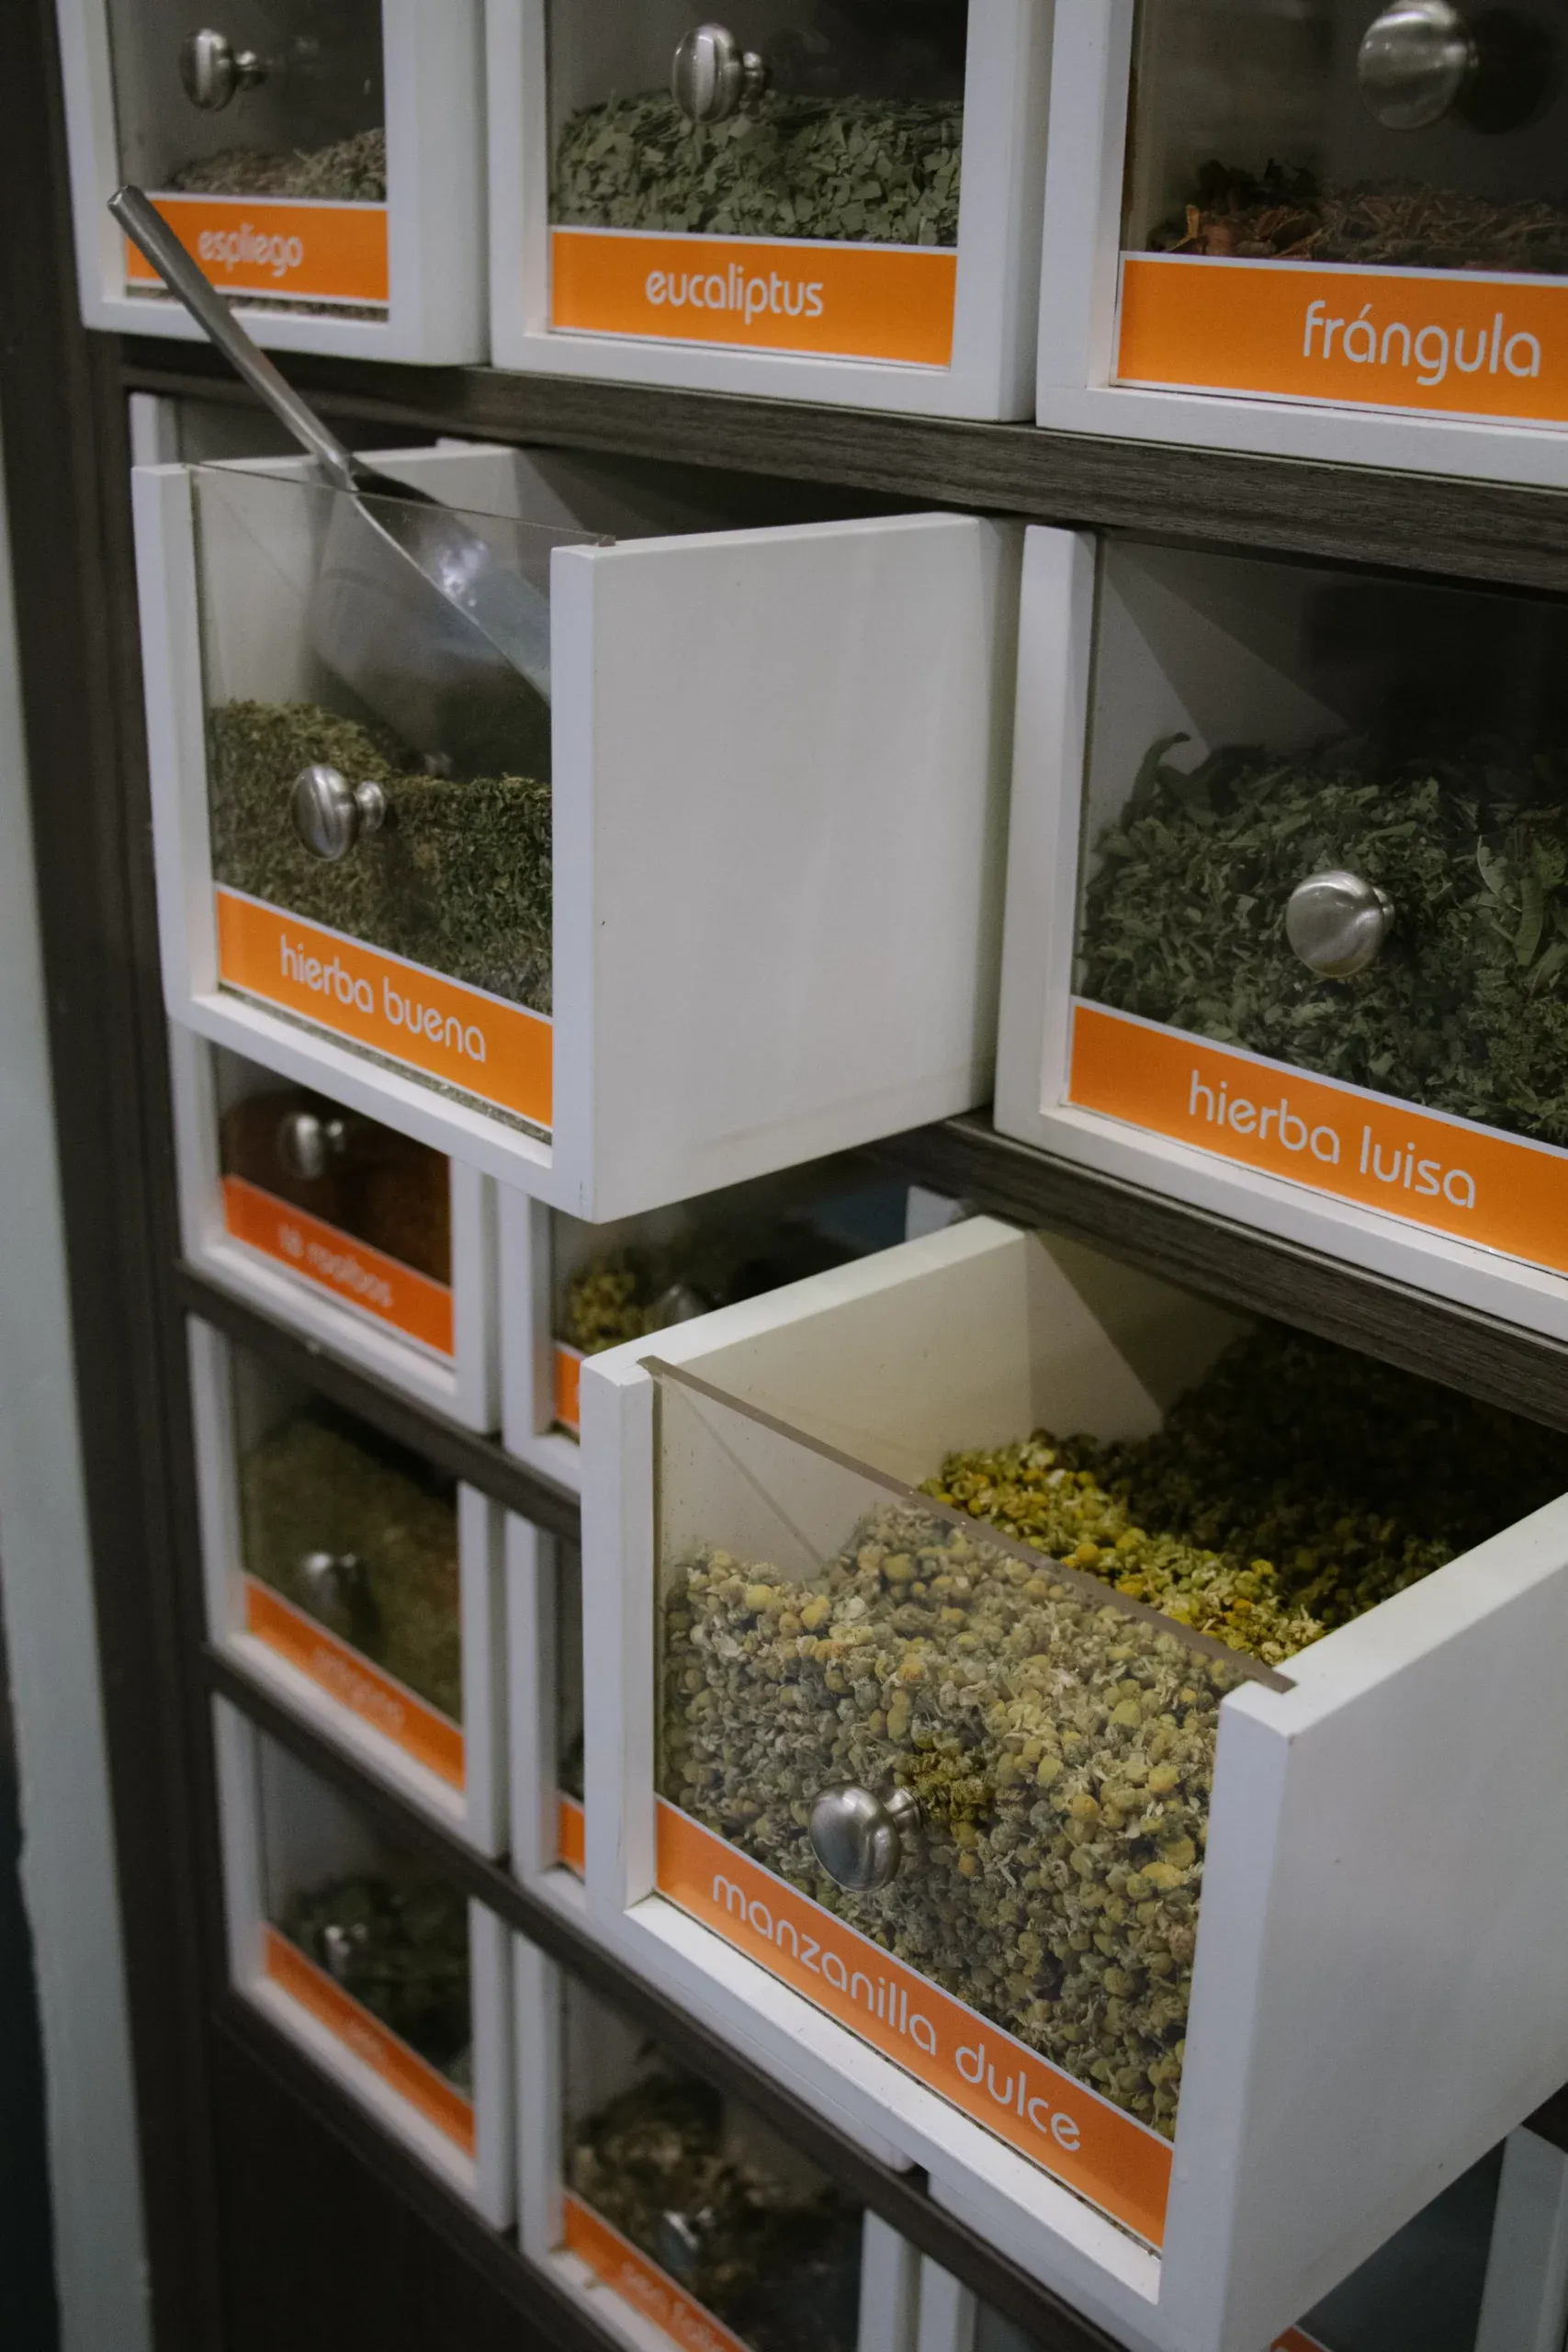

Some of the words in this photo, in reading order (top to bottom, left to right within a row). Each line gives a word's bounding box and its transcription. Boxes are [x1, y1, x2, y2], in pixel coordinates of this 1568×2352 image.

[646, 263, 824, 325] eucaliptus
[1303, 300, 1541, 387] frángula
[280, 933, 374, 1014] hierba
[383, 976, 487, 1063] buena
[1189, 1069, 1341, 1165] hierba
[1359, 1125, 1476, 1209] luisa
[712, 1874, 937, 2056] manzanilla
[955, 2043, 1081, 2152] dulce
